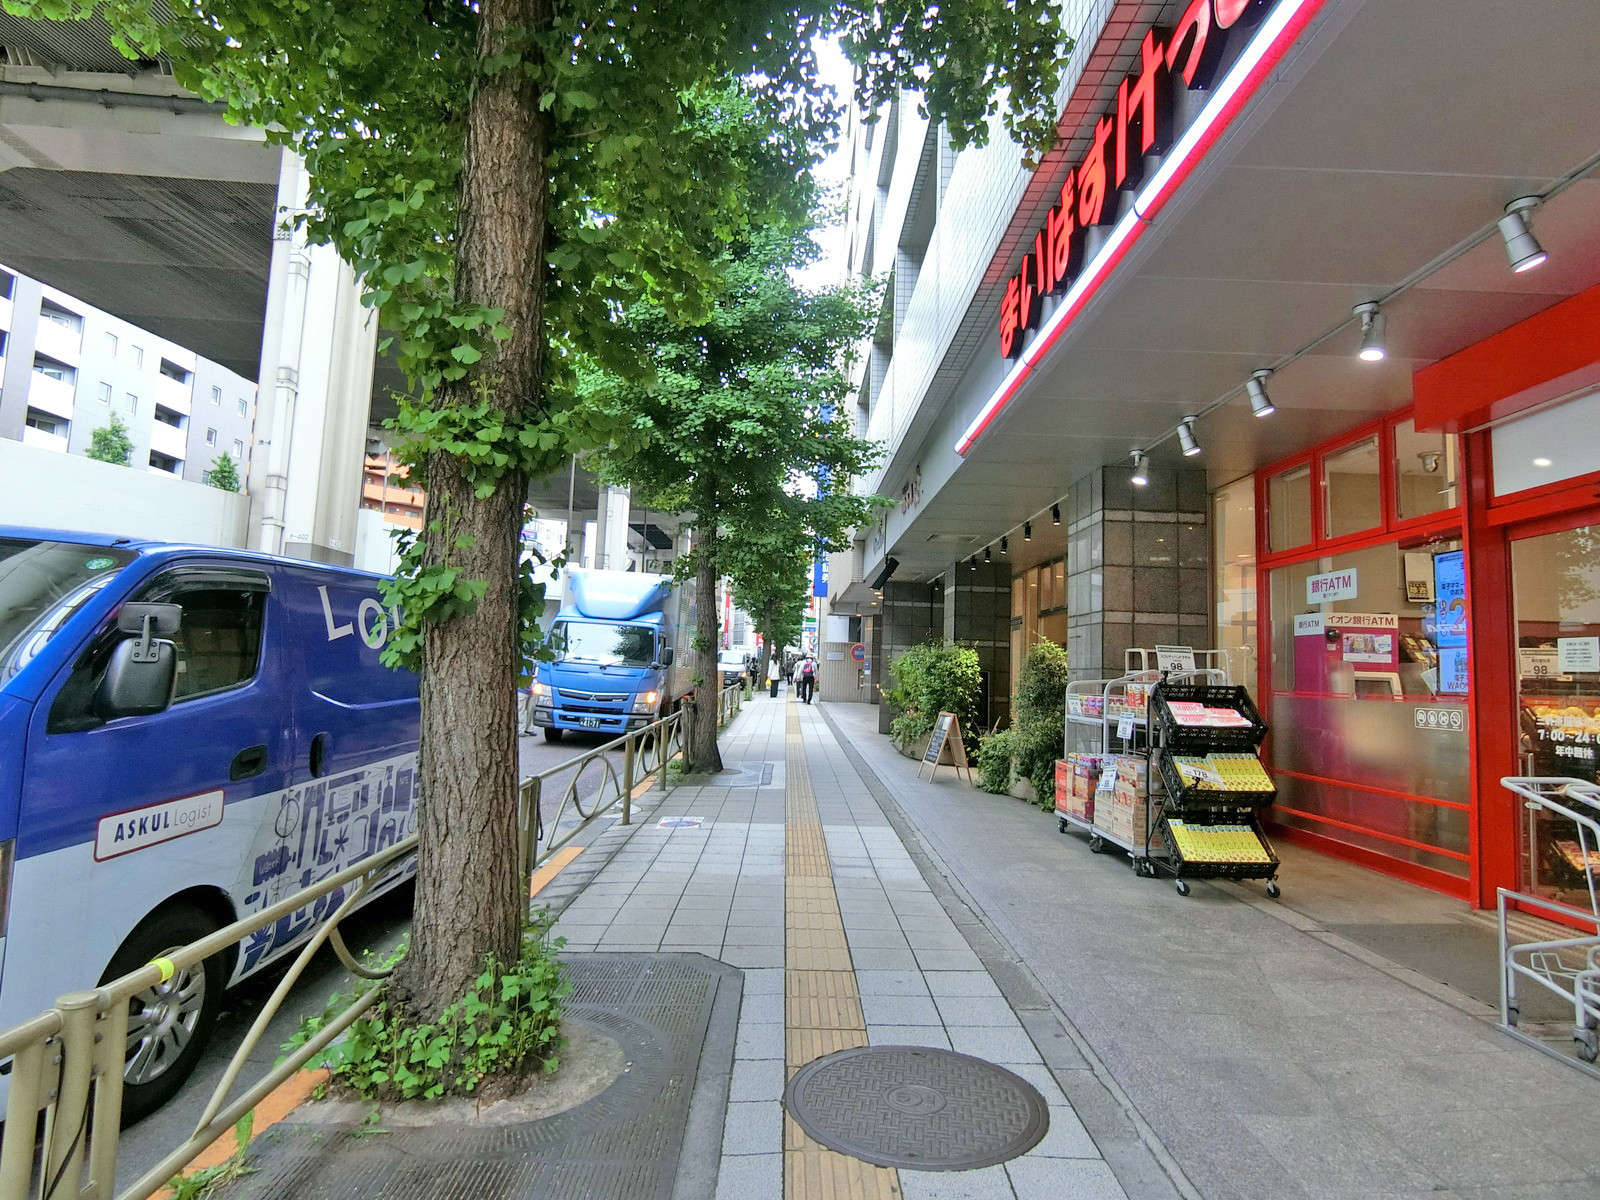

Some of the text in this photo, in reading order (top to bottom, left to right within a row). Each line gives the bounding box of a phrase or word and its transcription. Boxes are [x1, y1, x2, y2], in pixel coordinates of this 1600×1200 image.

[1311, 574, 1352, 594] 銀行ATM
[1298, 619, 1320, 629] 銀行ATM
[1328, 615, 1394, 626] イオン銀行ATM
[1170, 662, 1183, 671] 98
[1533, 665, 1548, 675] 98
[1555, 745, 1594, 759] 年中無休
[114, 802, 212, 843] ASKUL Logist
